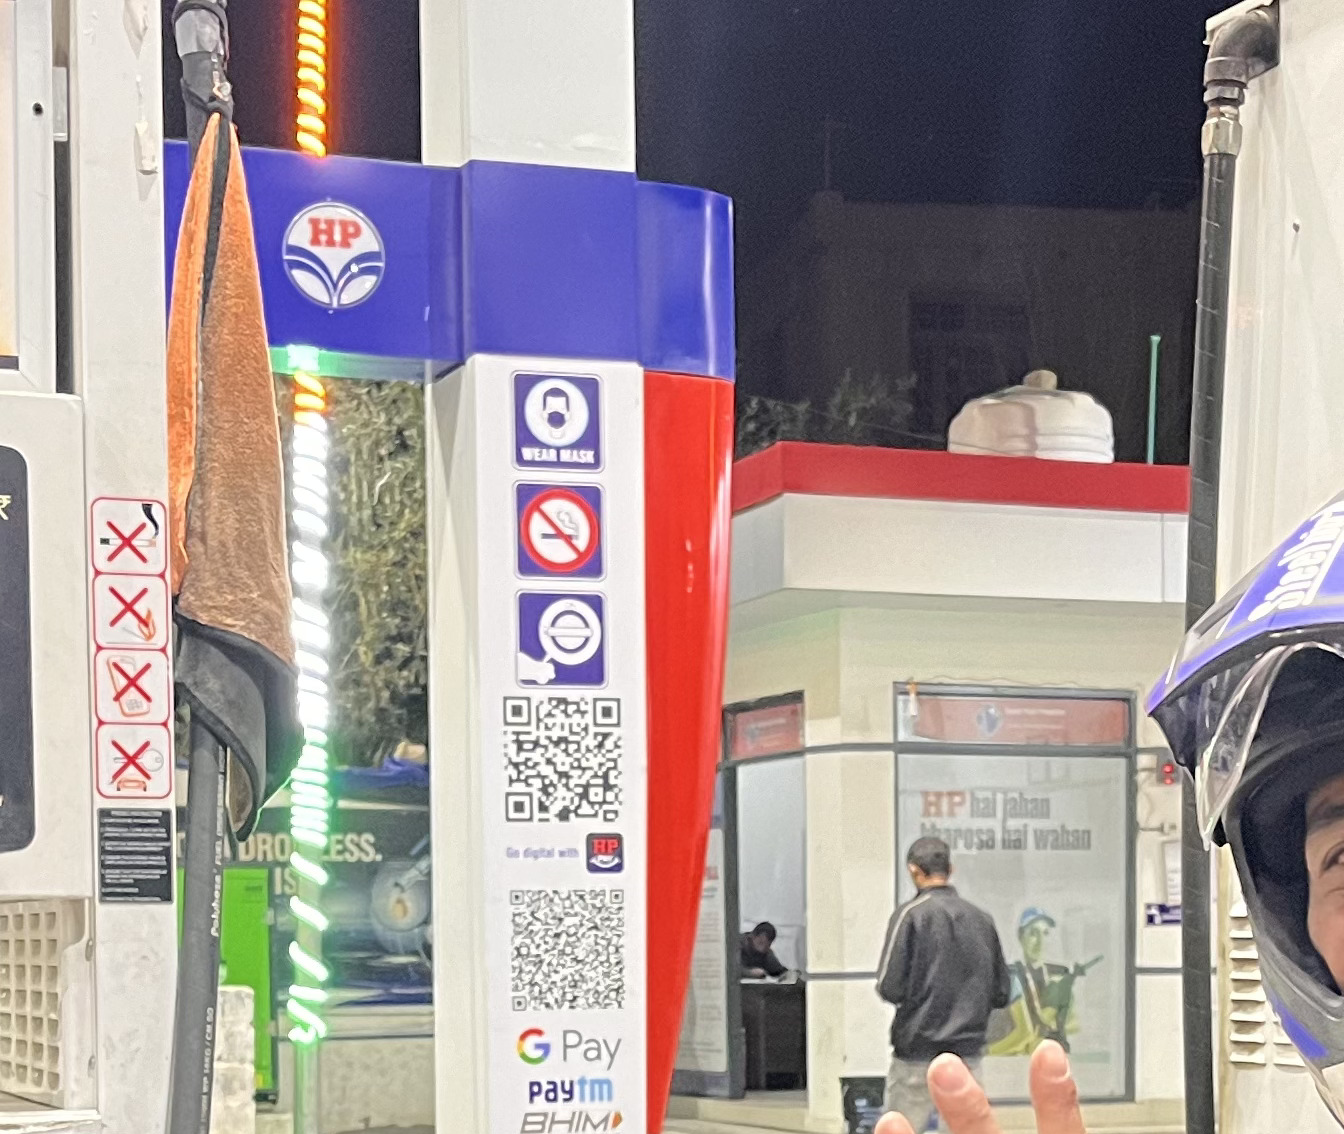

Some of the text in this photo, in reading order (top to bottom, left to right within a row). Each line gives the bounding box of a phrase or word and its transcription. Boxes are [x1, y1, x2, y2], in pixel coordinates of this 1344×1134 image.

[308, 217, 362, 248] HP
[521, 447, 595, 464] WEAR MASK
[920, 790, 966, 818] HP
[238, 832, 296, 862] DRO
[591, 837, 621, 856] HP
[516, 1028, 622, 1072] G Pay
[528, 1075, 613, 1105] paytm
[519, 1110, 611, 1134] BHIM
